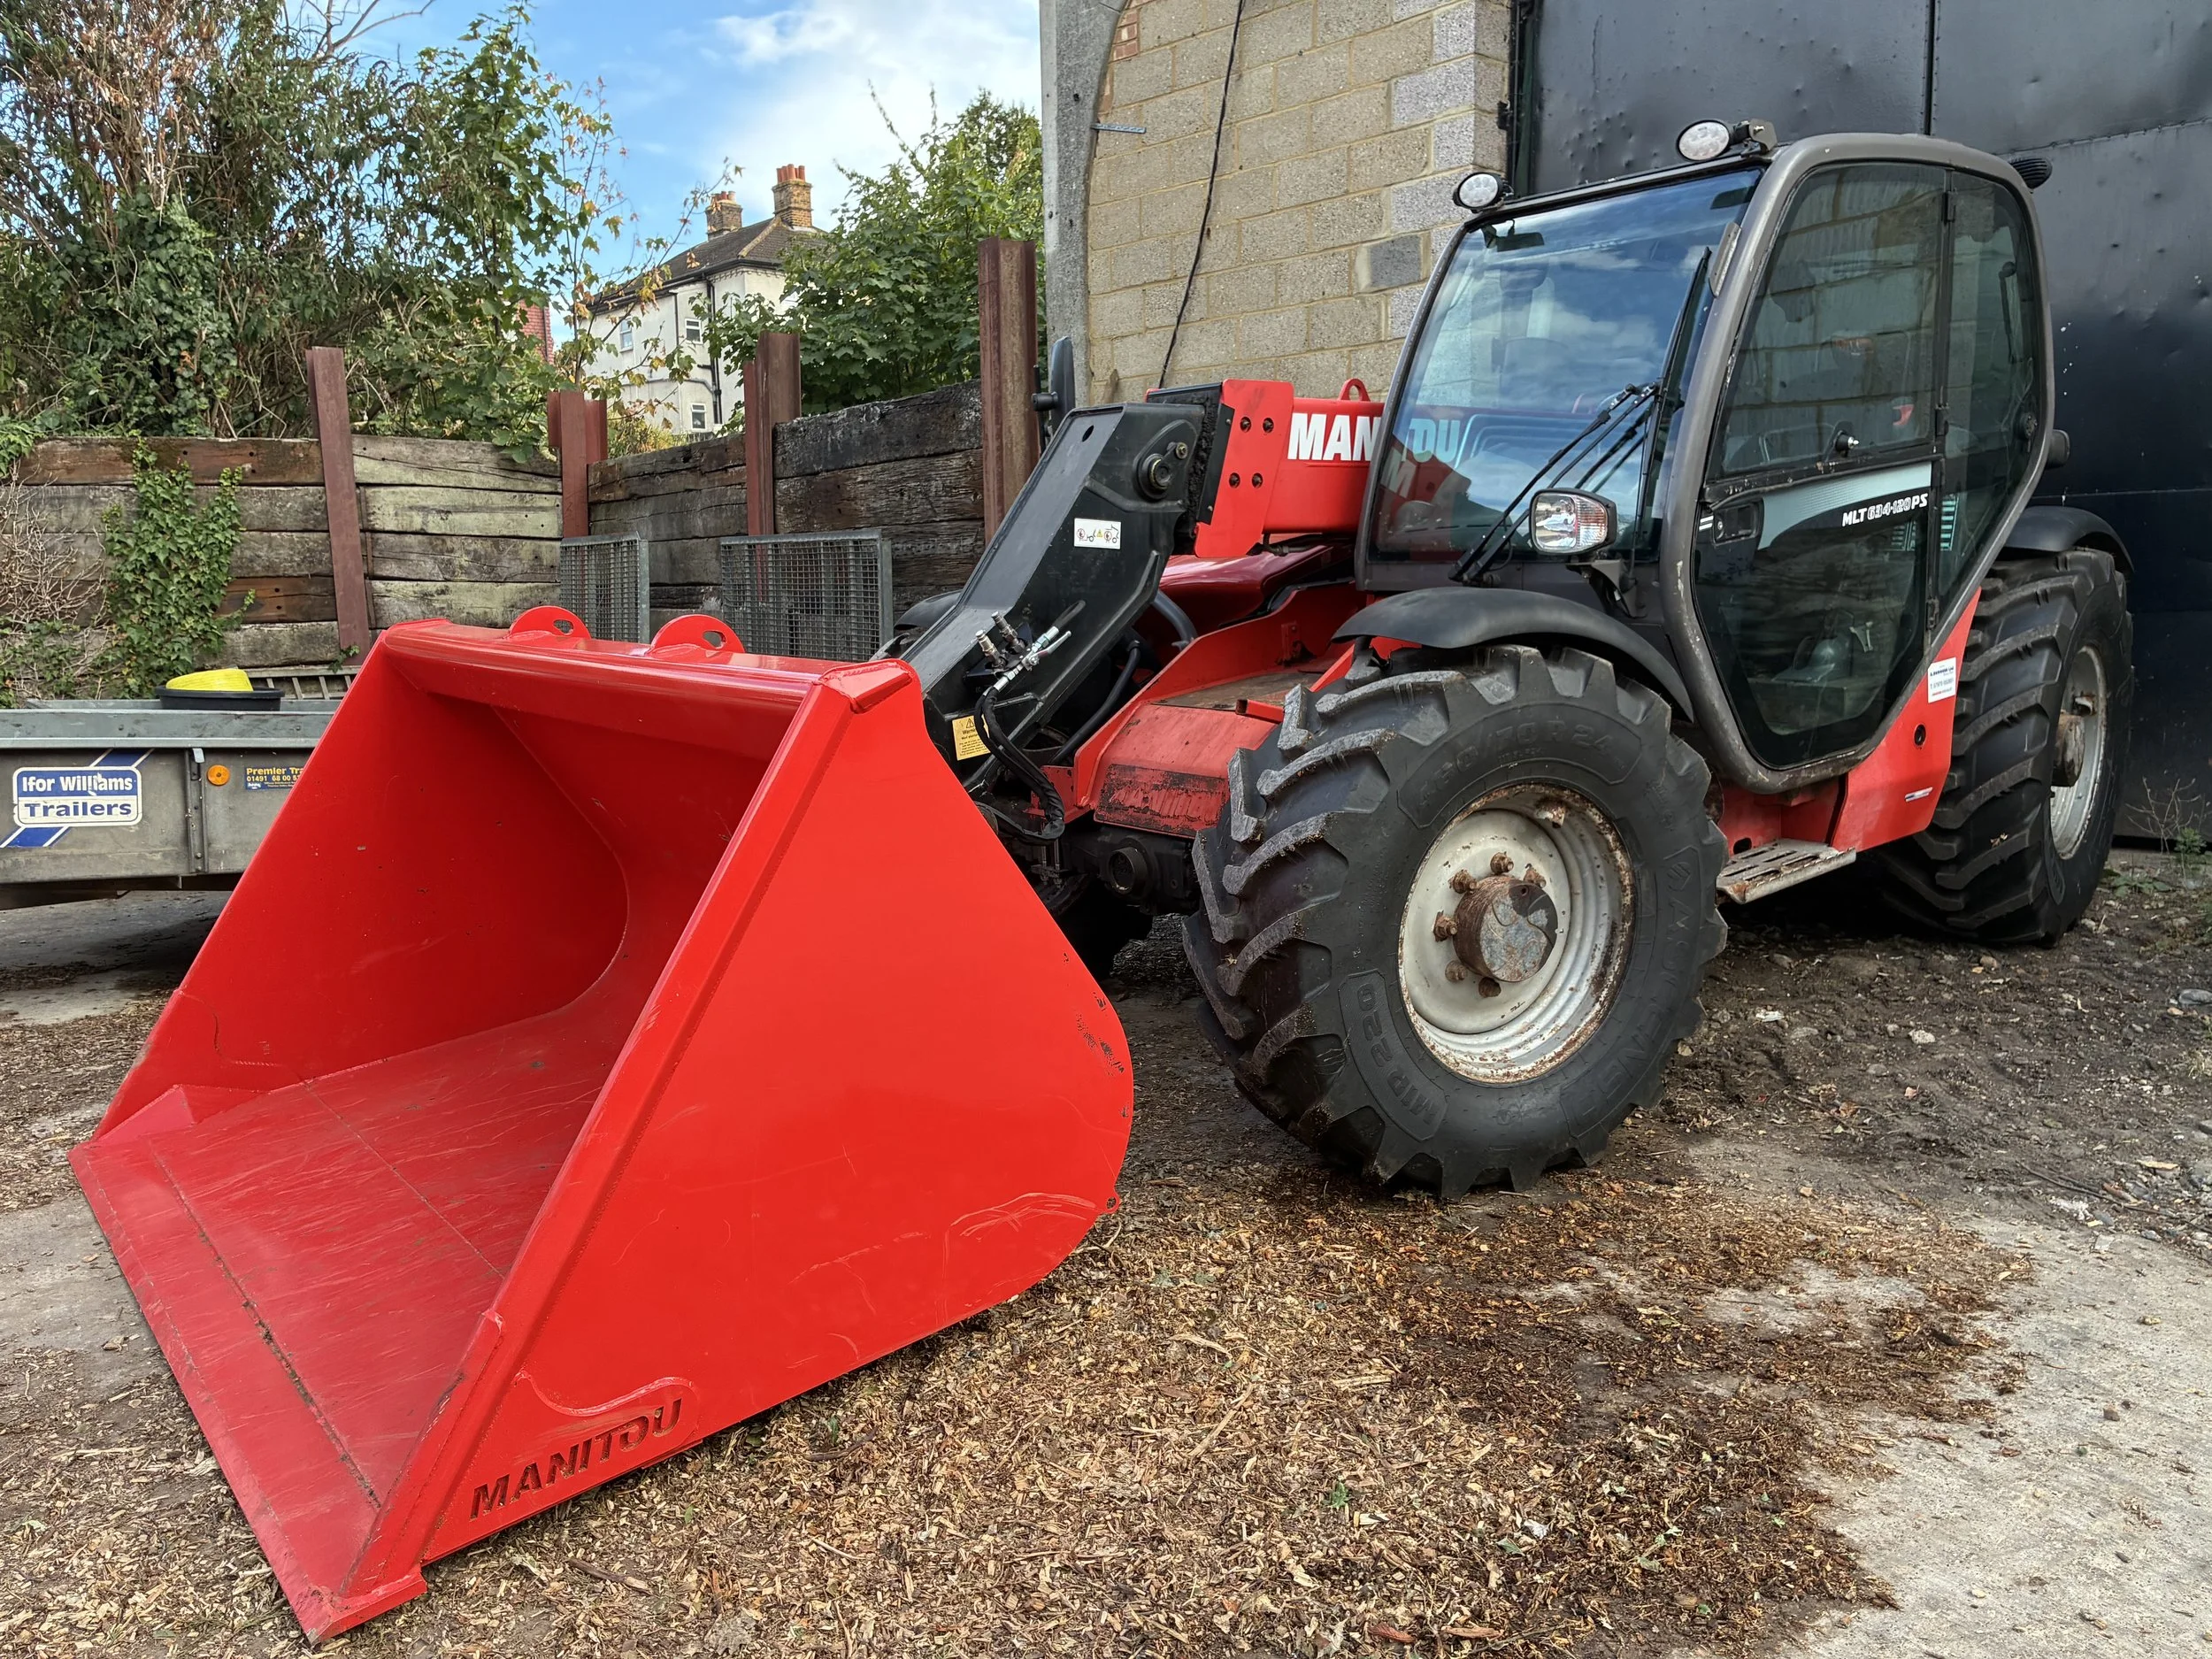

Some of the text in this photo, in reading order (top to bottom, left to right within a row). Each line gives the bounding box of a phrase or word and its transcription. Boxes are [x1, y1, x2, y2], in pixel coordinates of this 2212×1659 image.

[1286, 411, 1461, 464] MANOU
[22, 775, 133, 792] Ifor Williams
[24, 801, 132, 818] Trailers
[468, 1398, 682, 1522] MANITOU
